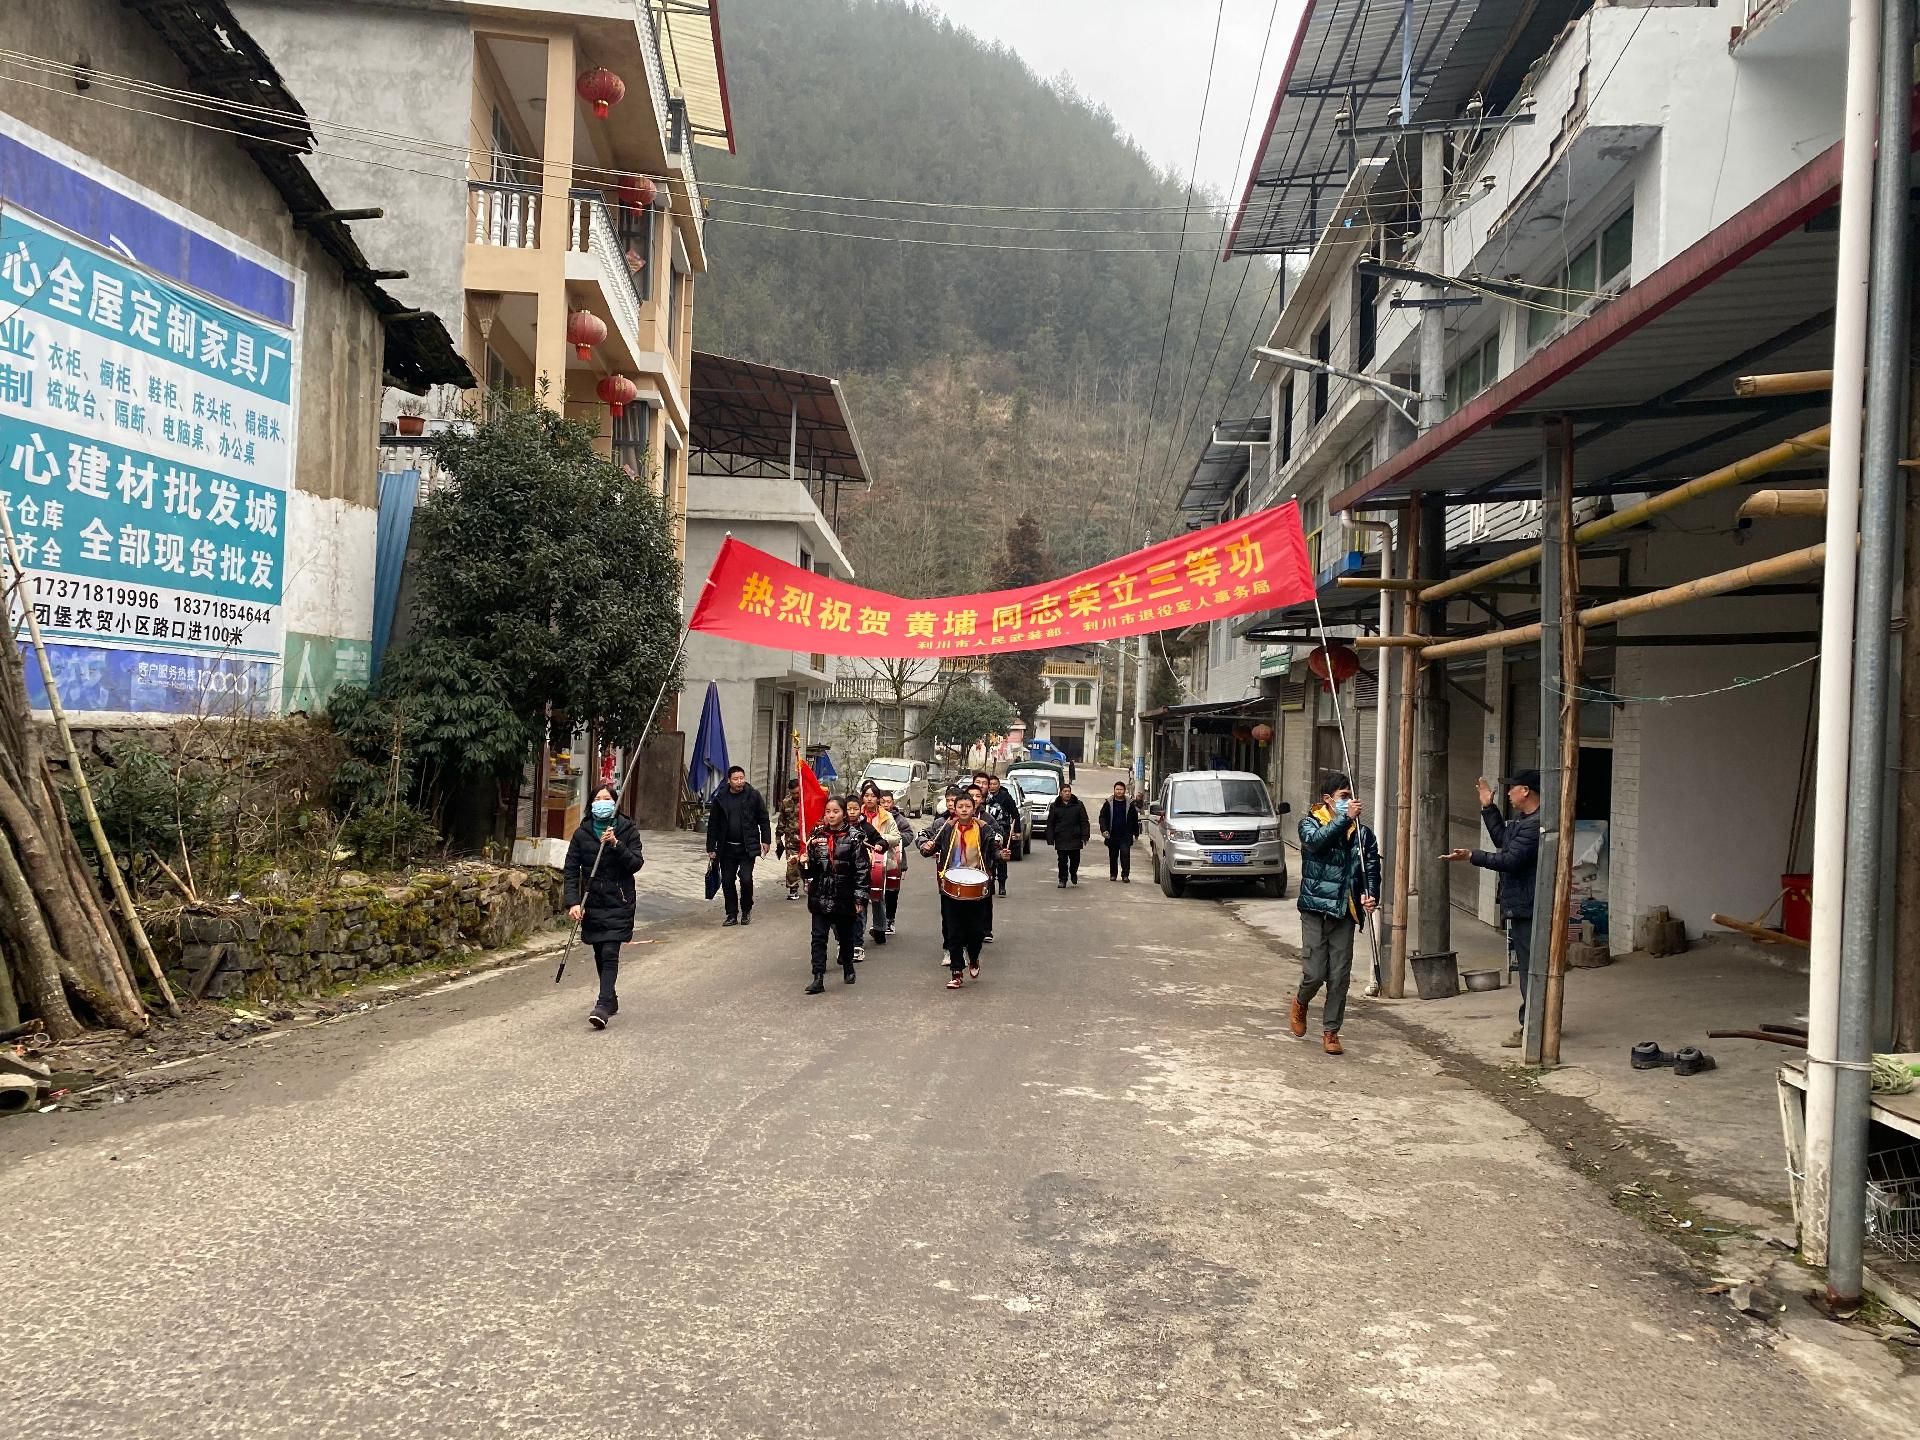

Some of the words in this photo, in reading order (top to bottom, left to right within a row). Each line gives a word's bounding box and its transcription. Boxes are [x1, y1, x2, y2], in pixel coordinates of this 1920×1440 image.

[2, 241, 286, 386] 心全屋定制家具厂
[10, 432, 278, 538] 心建材批发城
[79, 517, 274, 590] 全部现货批发
[33, 577, 159, 609] 17371819996
[174, 596, 271, 624] 18371854644
[33, 603, 243, 646] 团堡农贸小区路口进100米
